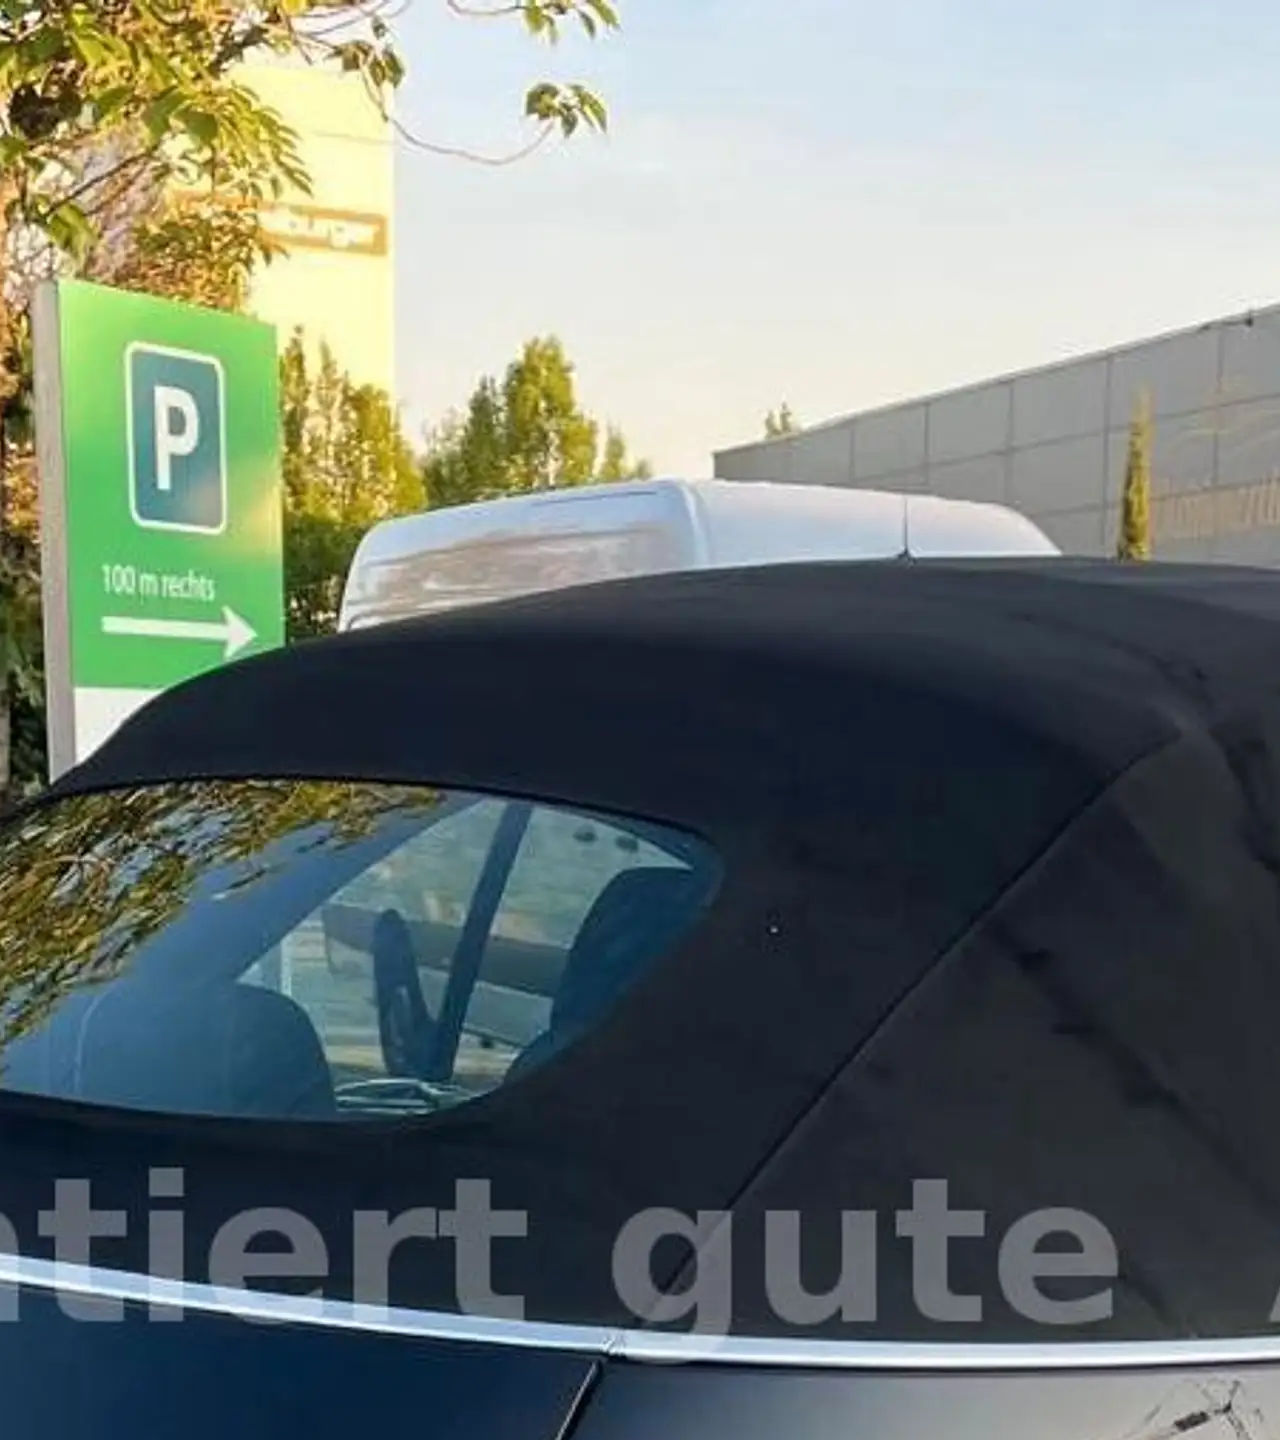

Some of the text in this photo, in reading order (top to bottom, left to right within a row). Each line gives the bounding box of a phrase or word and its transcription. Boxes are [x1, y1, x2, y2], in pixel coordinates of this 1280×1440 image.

[153, 385, 200, 490] P
[102, 564, 216, 602] 100 m rechts
